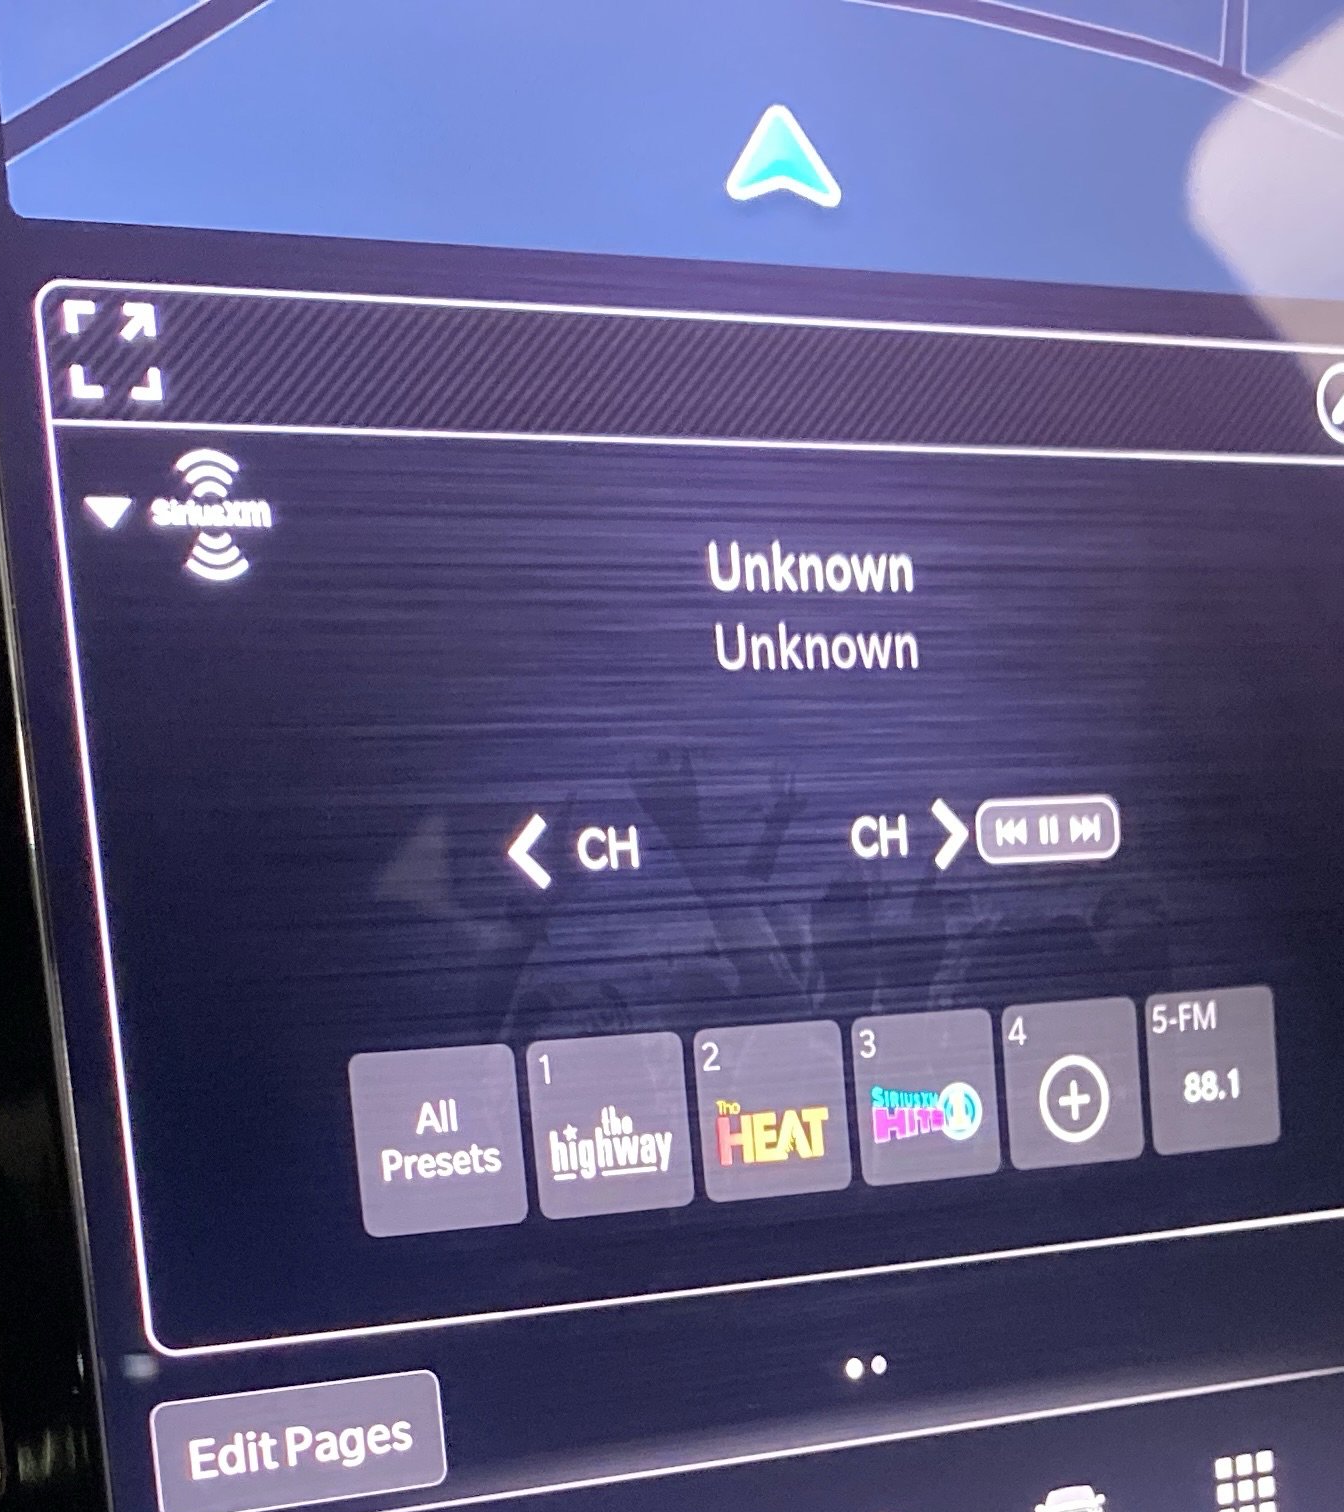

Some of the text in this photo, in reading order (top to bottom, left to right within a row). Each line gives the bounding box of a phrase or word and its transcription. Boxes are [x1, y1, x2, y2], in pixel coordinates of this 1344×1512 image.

[707, 539, 915, 592] Unknown
[713, 620, 920, 671] Unknown
[576, 825, 640, 872] CH
[849, 814, 910, 859] CH
[1007, 1016, 1027, 1046] 4
[1151, 1001, 1218, 1034] 5-FM
[701, 1041, 722, 1072] 2
[858, 1029, 878, 1059] 3
[537, 1054, 553, 1085] 1
[1183, 1067, 1241, 1103] 88.1
[415, 1097, 459, 1136] All
[549, 1126, 673, 1179] highway
[717, 1107, 829, 1167] HEAT
[381, 1143, 503, 1182] Presets
[187, 1419, 414, 1482] Edit Pages
